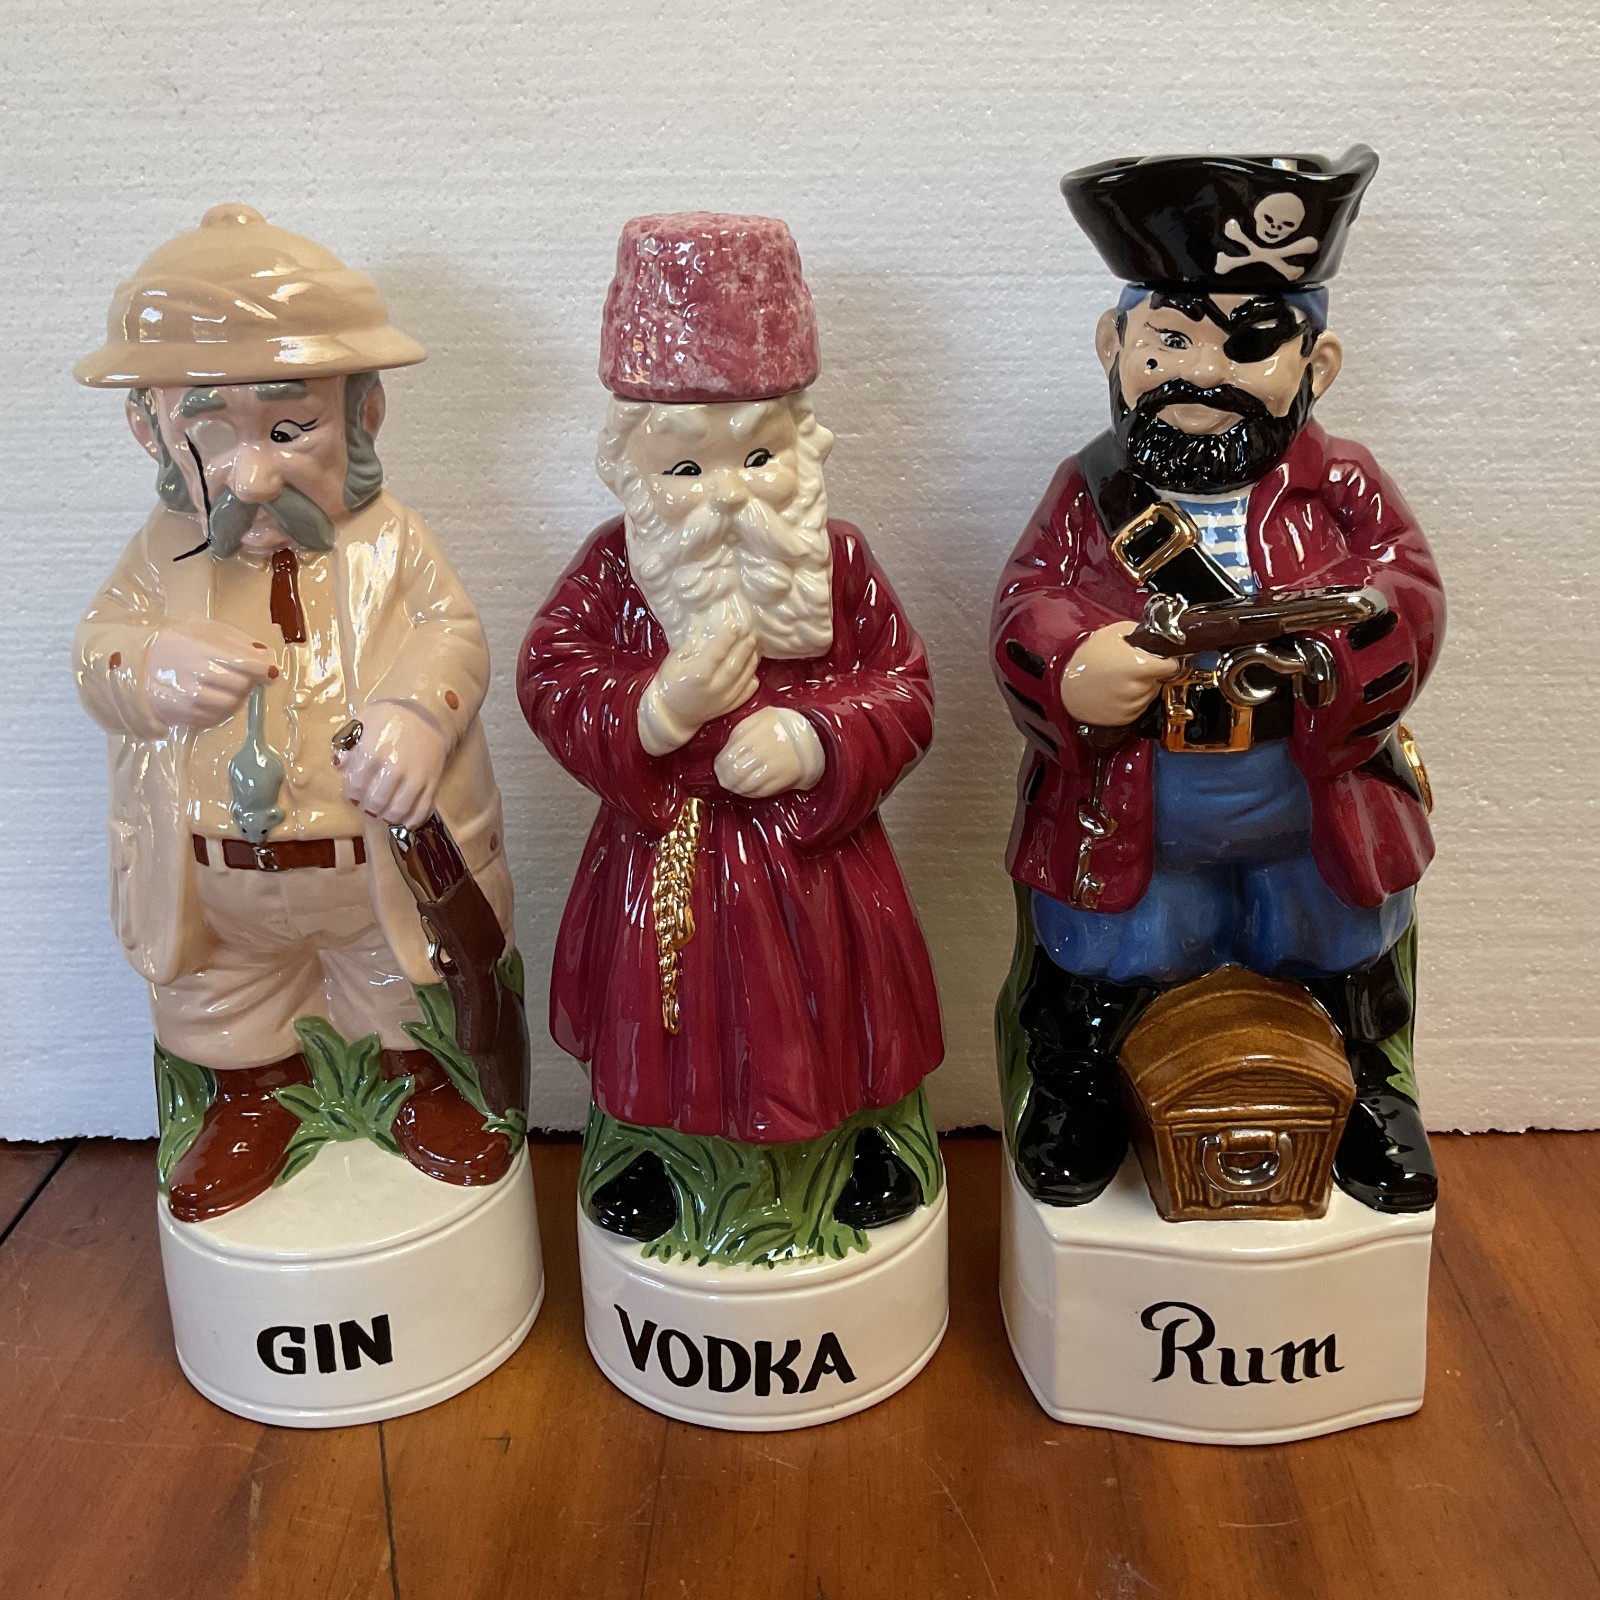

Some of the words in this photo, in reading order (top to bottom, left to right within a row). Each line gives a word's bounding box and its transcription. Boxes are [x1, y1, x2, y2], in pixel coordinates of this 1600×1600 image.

[256, 1313, 394, 1375] GIN
[613, 1303, 857, 1397] VODKA
[1140, 1301, 1345, 1387] Rum
